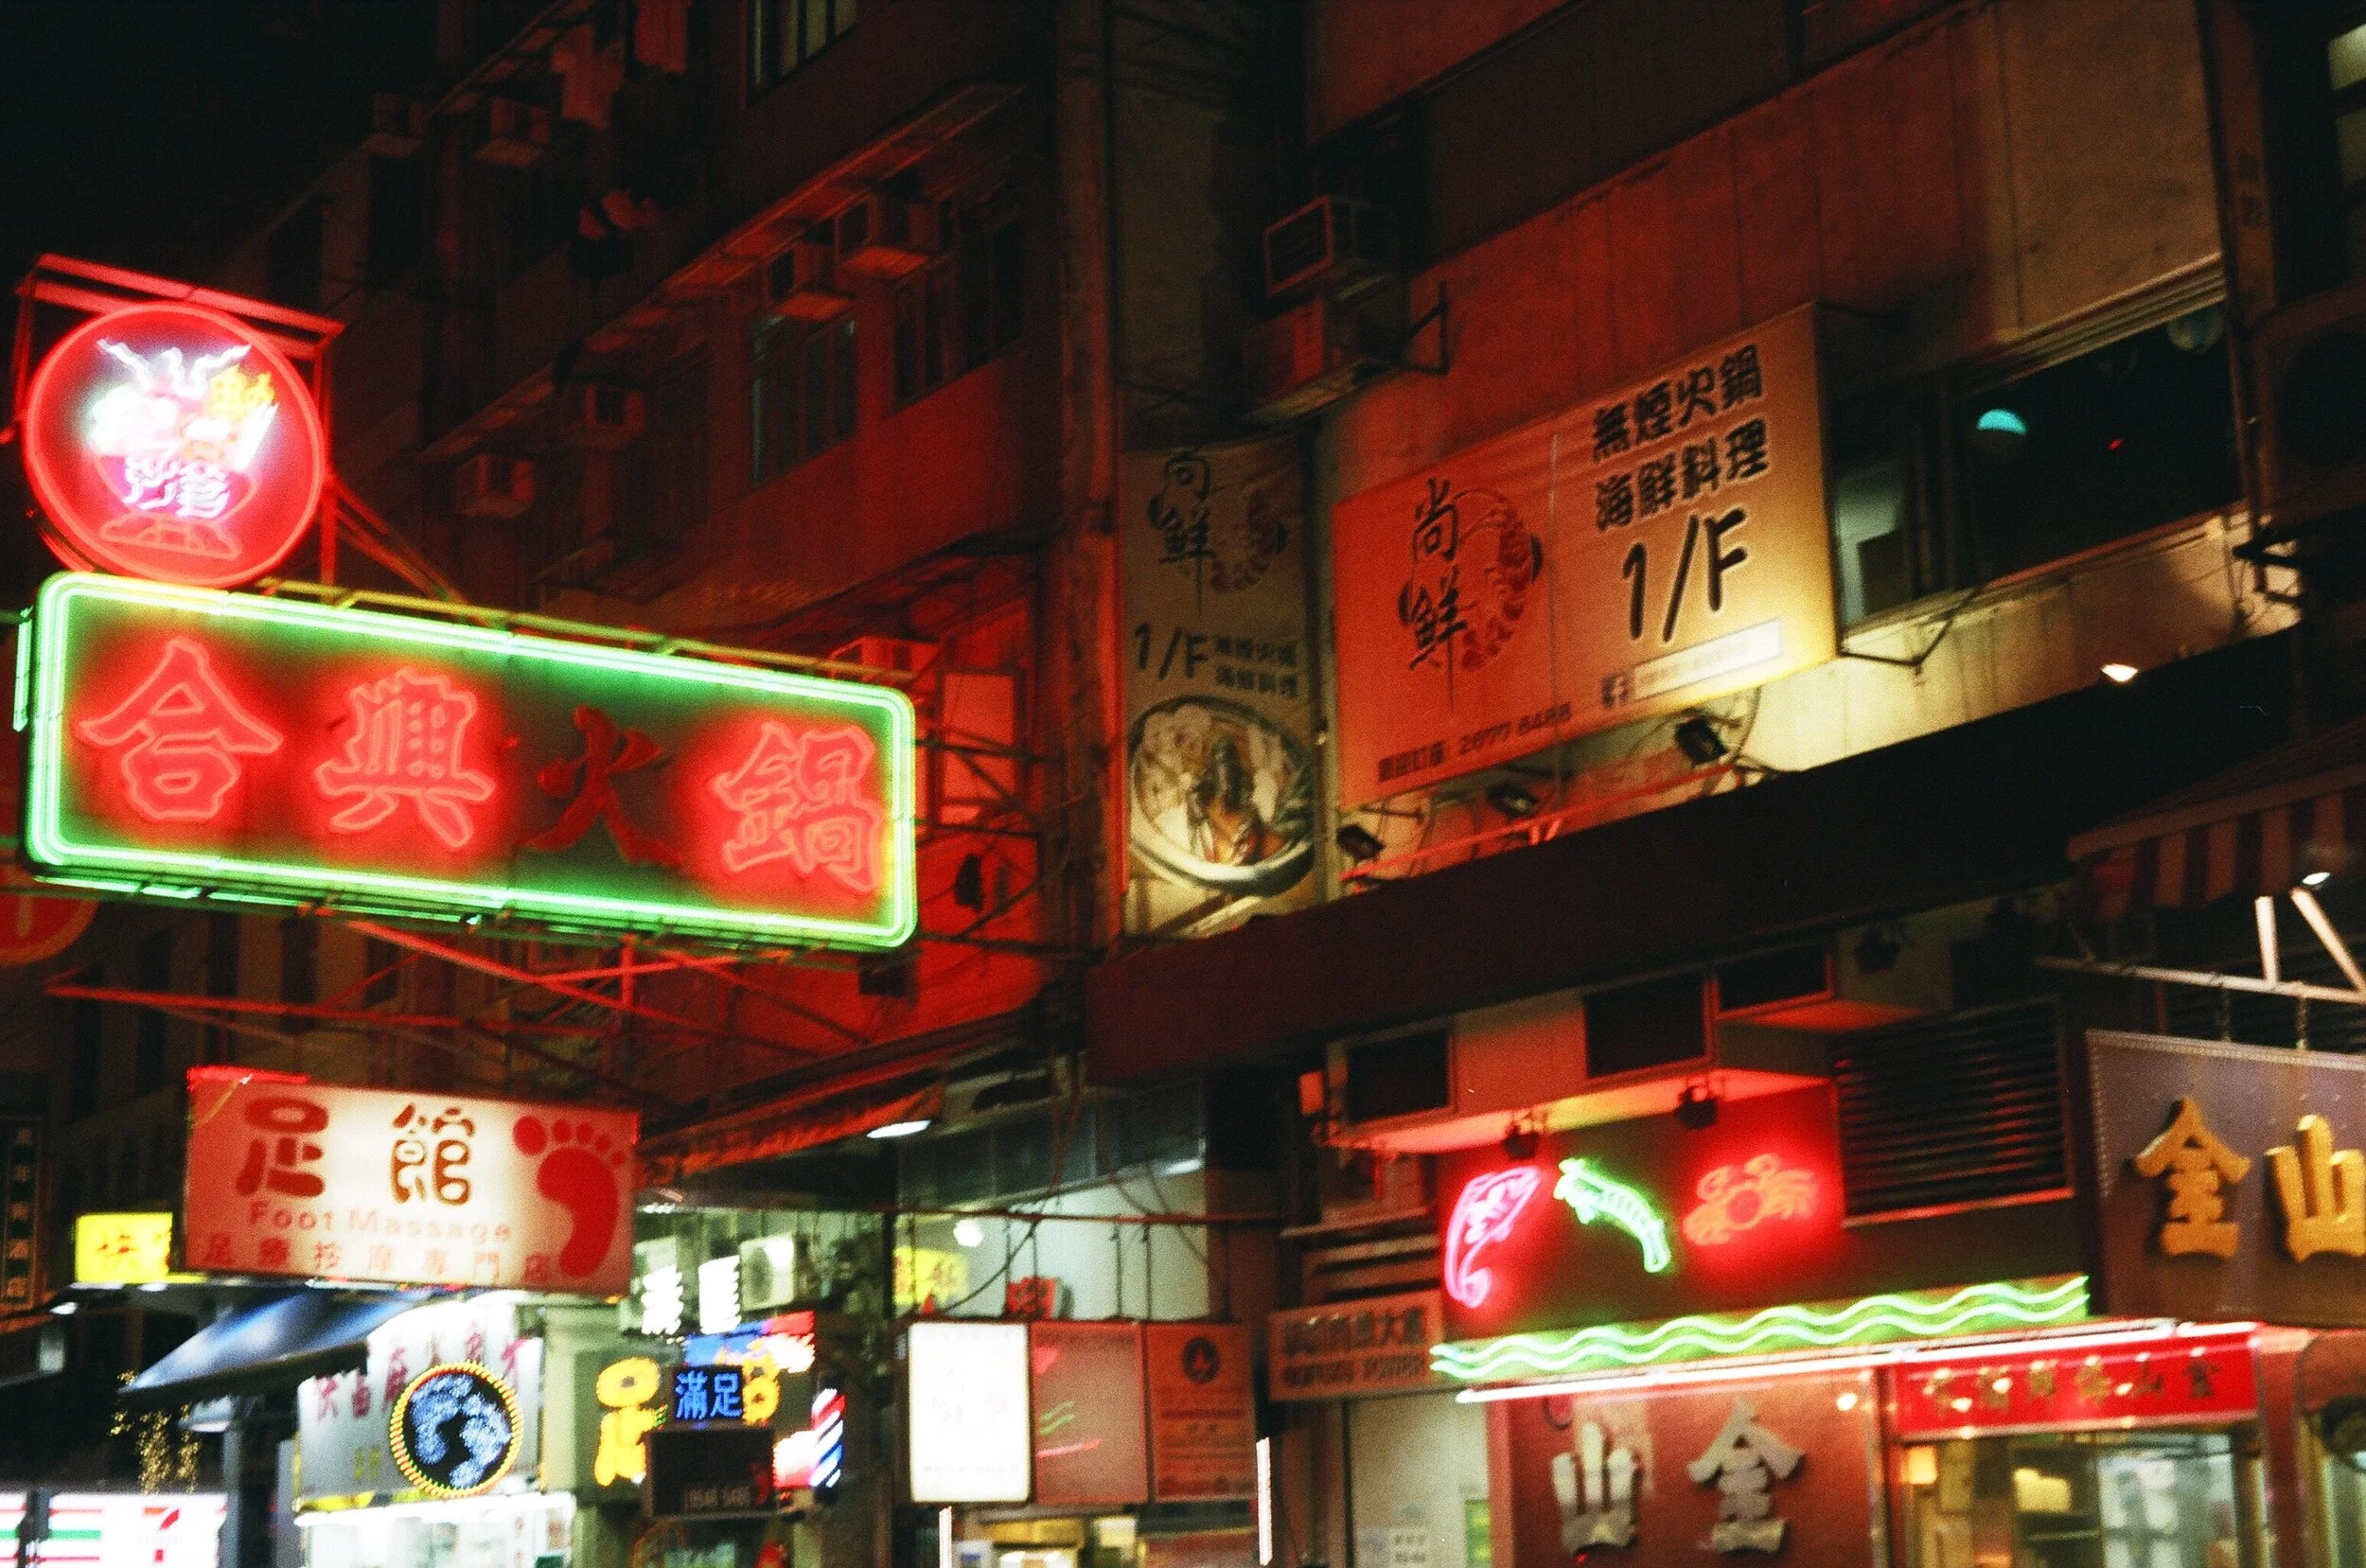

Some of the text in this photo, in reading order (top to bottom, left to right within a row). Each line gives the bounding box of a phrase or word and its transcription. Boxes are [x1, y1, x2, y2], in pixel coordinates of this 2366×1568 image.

[1593, 344, 1762, 462] 無煙火鍋
[1596, 418, 1768, 531] 海鮮料理
[1408, 477, 1468, 710] 尚鮮
[1622, 507, 1747, 642] 1/F
[1136, 625, 1208, 680] 1/F
[78, 636, 882, 893] 合興火鍋
[236, 1096, 476, 1206] 足館
[2134, 1096, 2366, 1262] 金山
[248, 1200, 512, 1244] Foot Massage
[675, 1368, 744, 1419] 滿足
